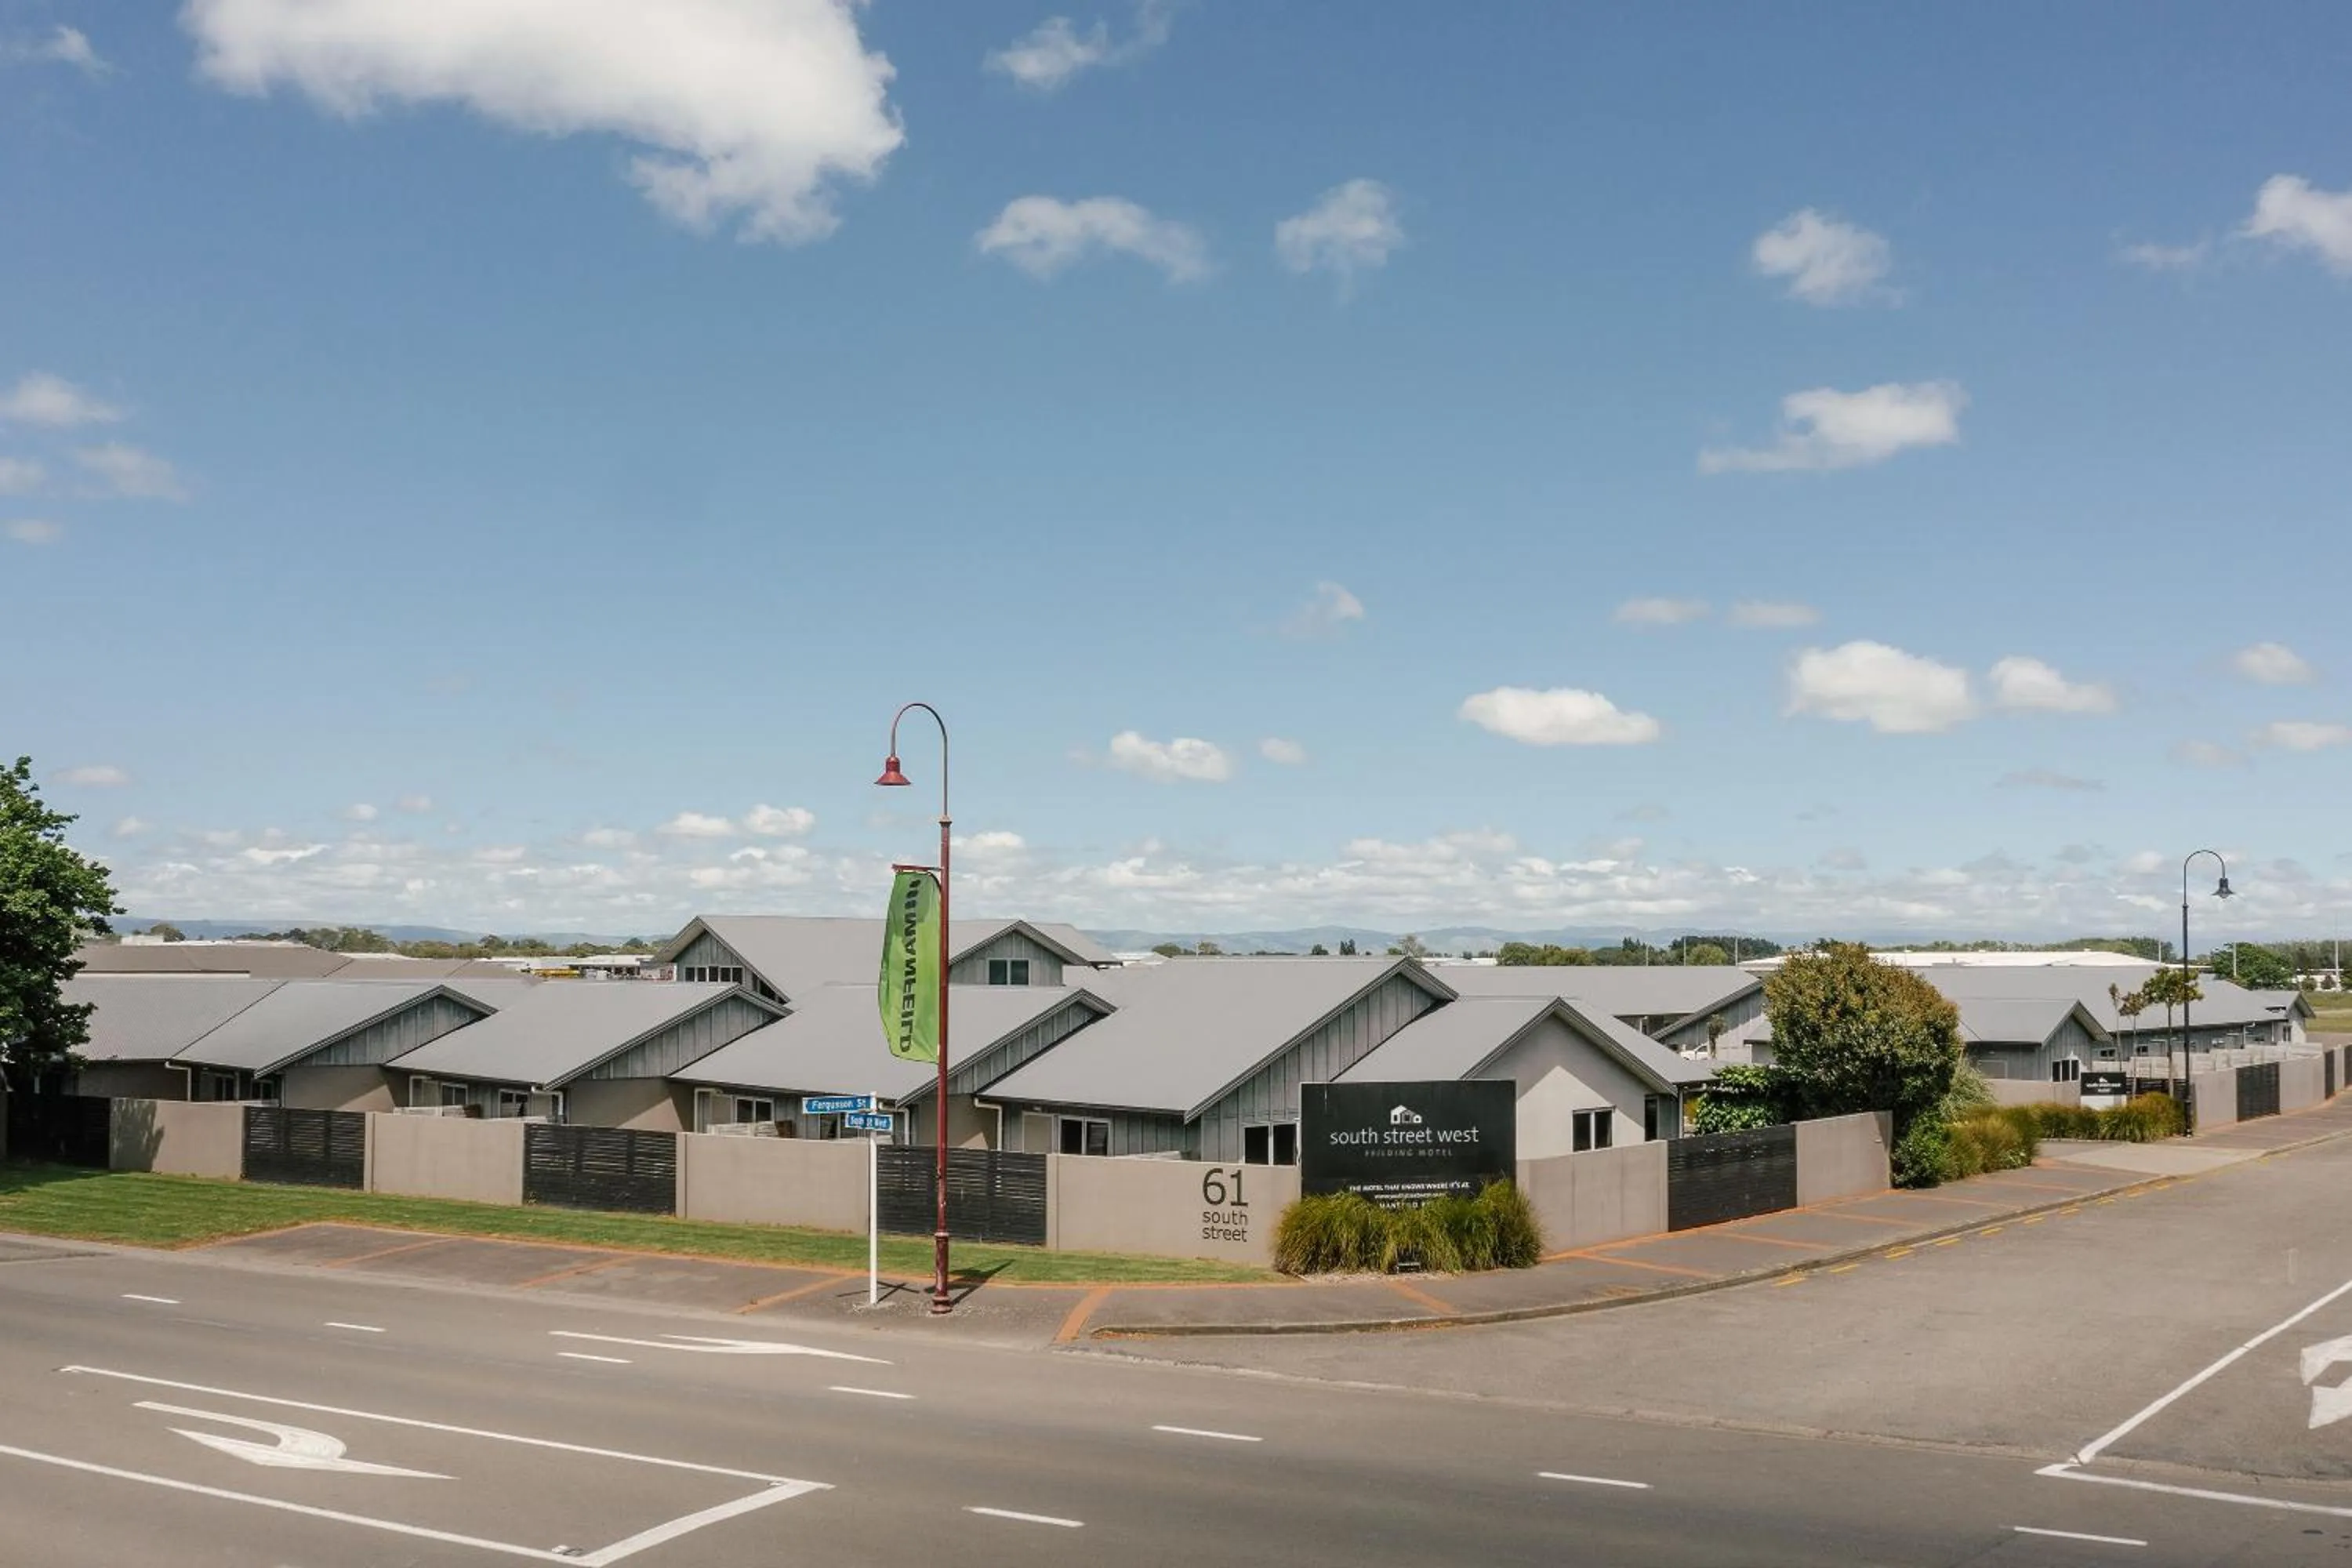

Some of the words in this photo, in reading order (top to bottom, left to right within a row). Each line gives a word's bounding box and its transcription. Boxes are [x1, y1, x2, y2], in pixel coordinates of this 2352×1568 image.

[857, 1098, 866, 1107] St
[1330, 1127, 1377, 1145] south
[1383, 1127, 1432, 1144] street
[1437, 1126, 1479, 1142] west
[1418, 1148, 1453, 1156] MOTEL
[1203, 1168, 1248, 1207] 61
[1203, 1210, 1247, 1225] south
[1203, 1225, 1247, 1242] street
